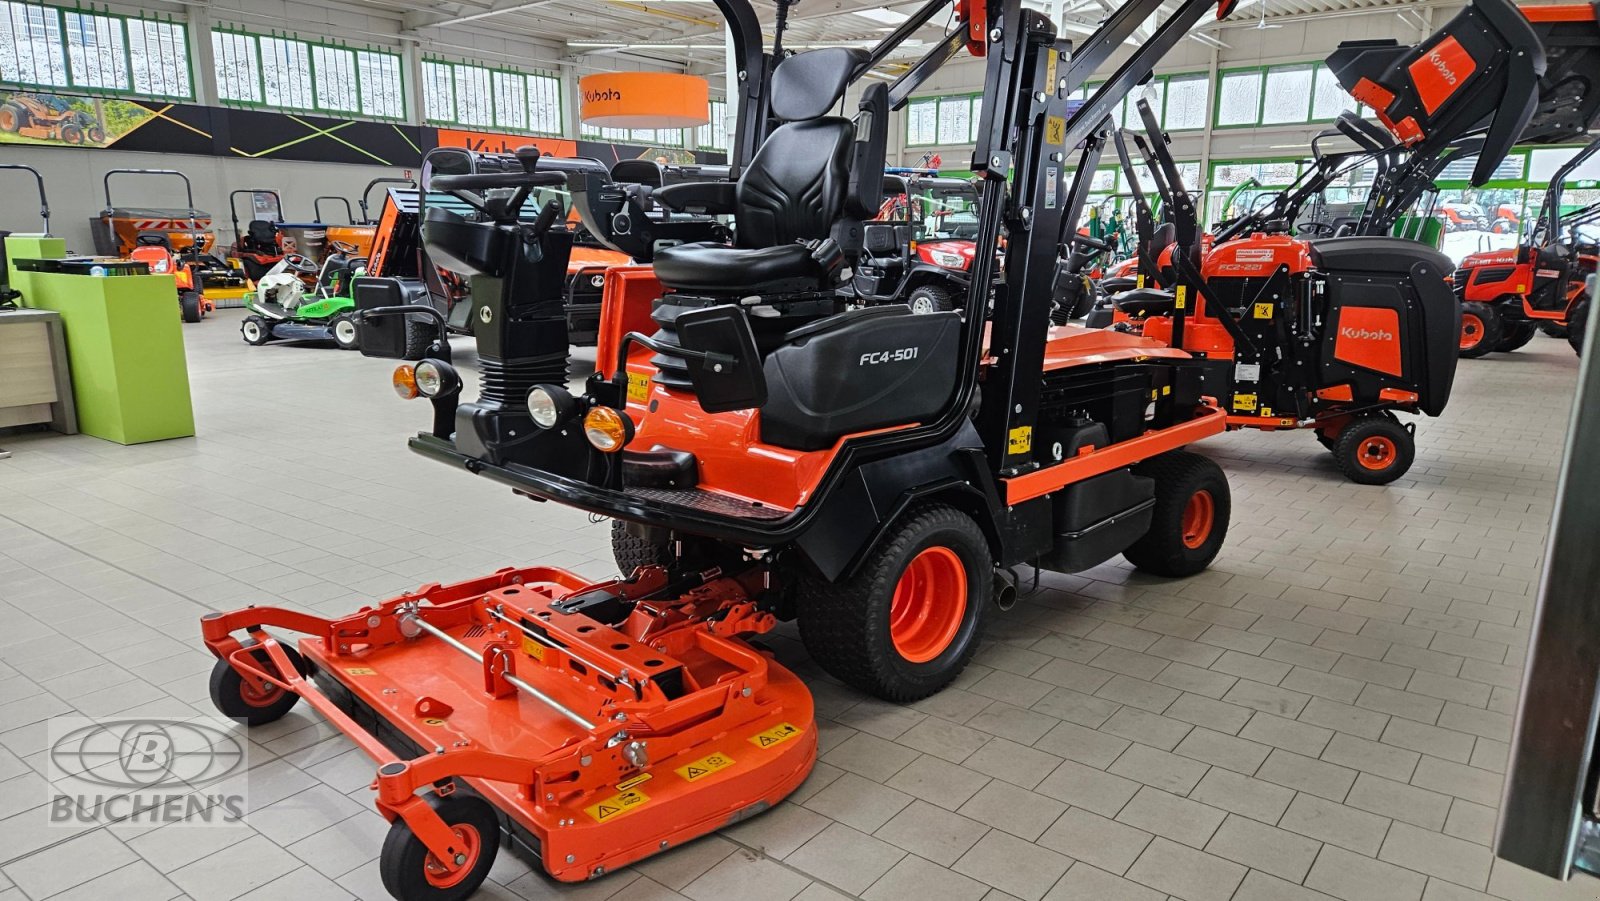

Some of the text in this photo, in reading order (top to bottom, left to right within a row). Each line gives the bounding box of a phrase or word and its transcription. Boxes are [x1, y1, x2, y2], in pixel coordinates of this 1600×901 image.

[1429, 50, 1457, 86] Kubota
[584, 87, 621, 102] Kubota
[1341, 326, 1393, 342] Kubota
[859, 346, 919, 366] FC4-501
